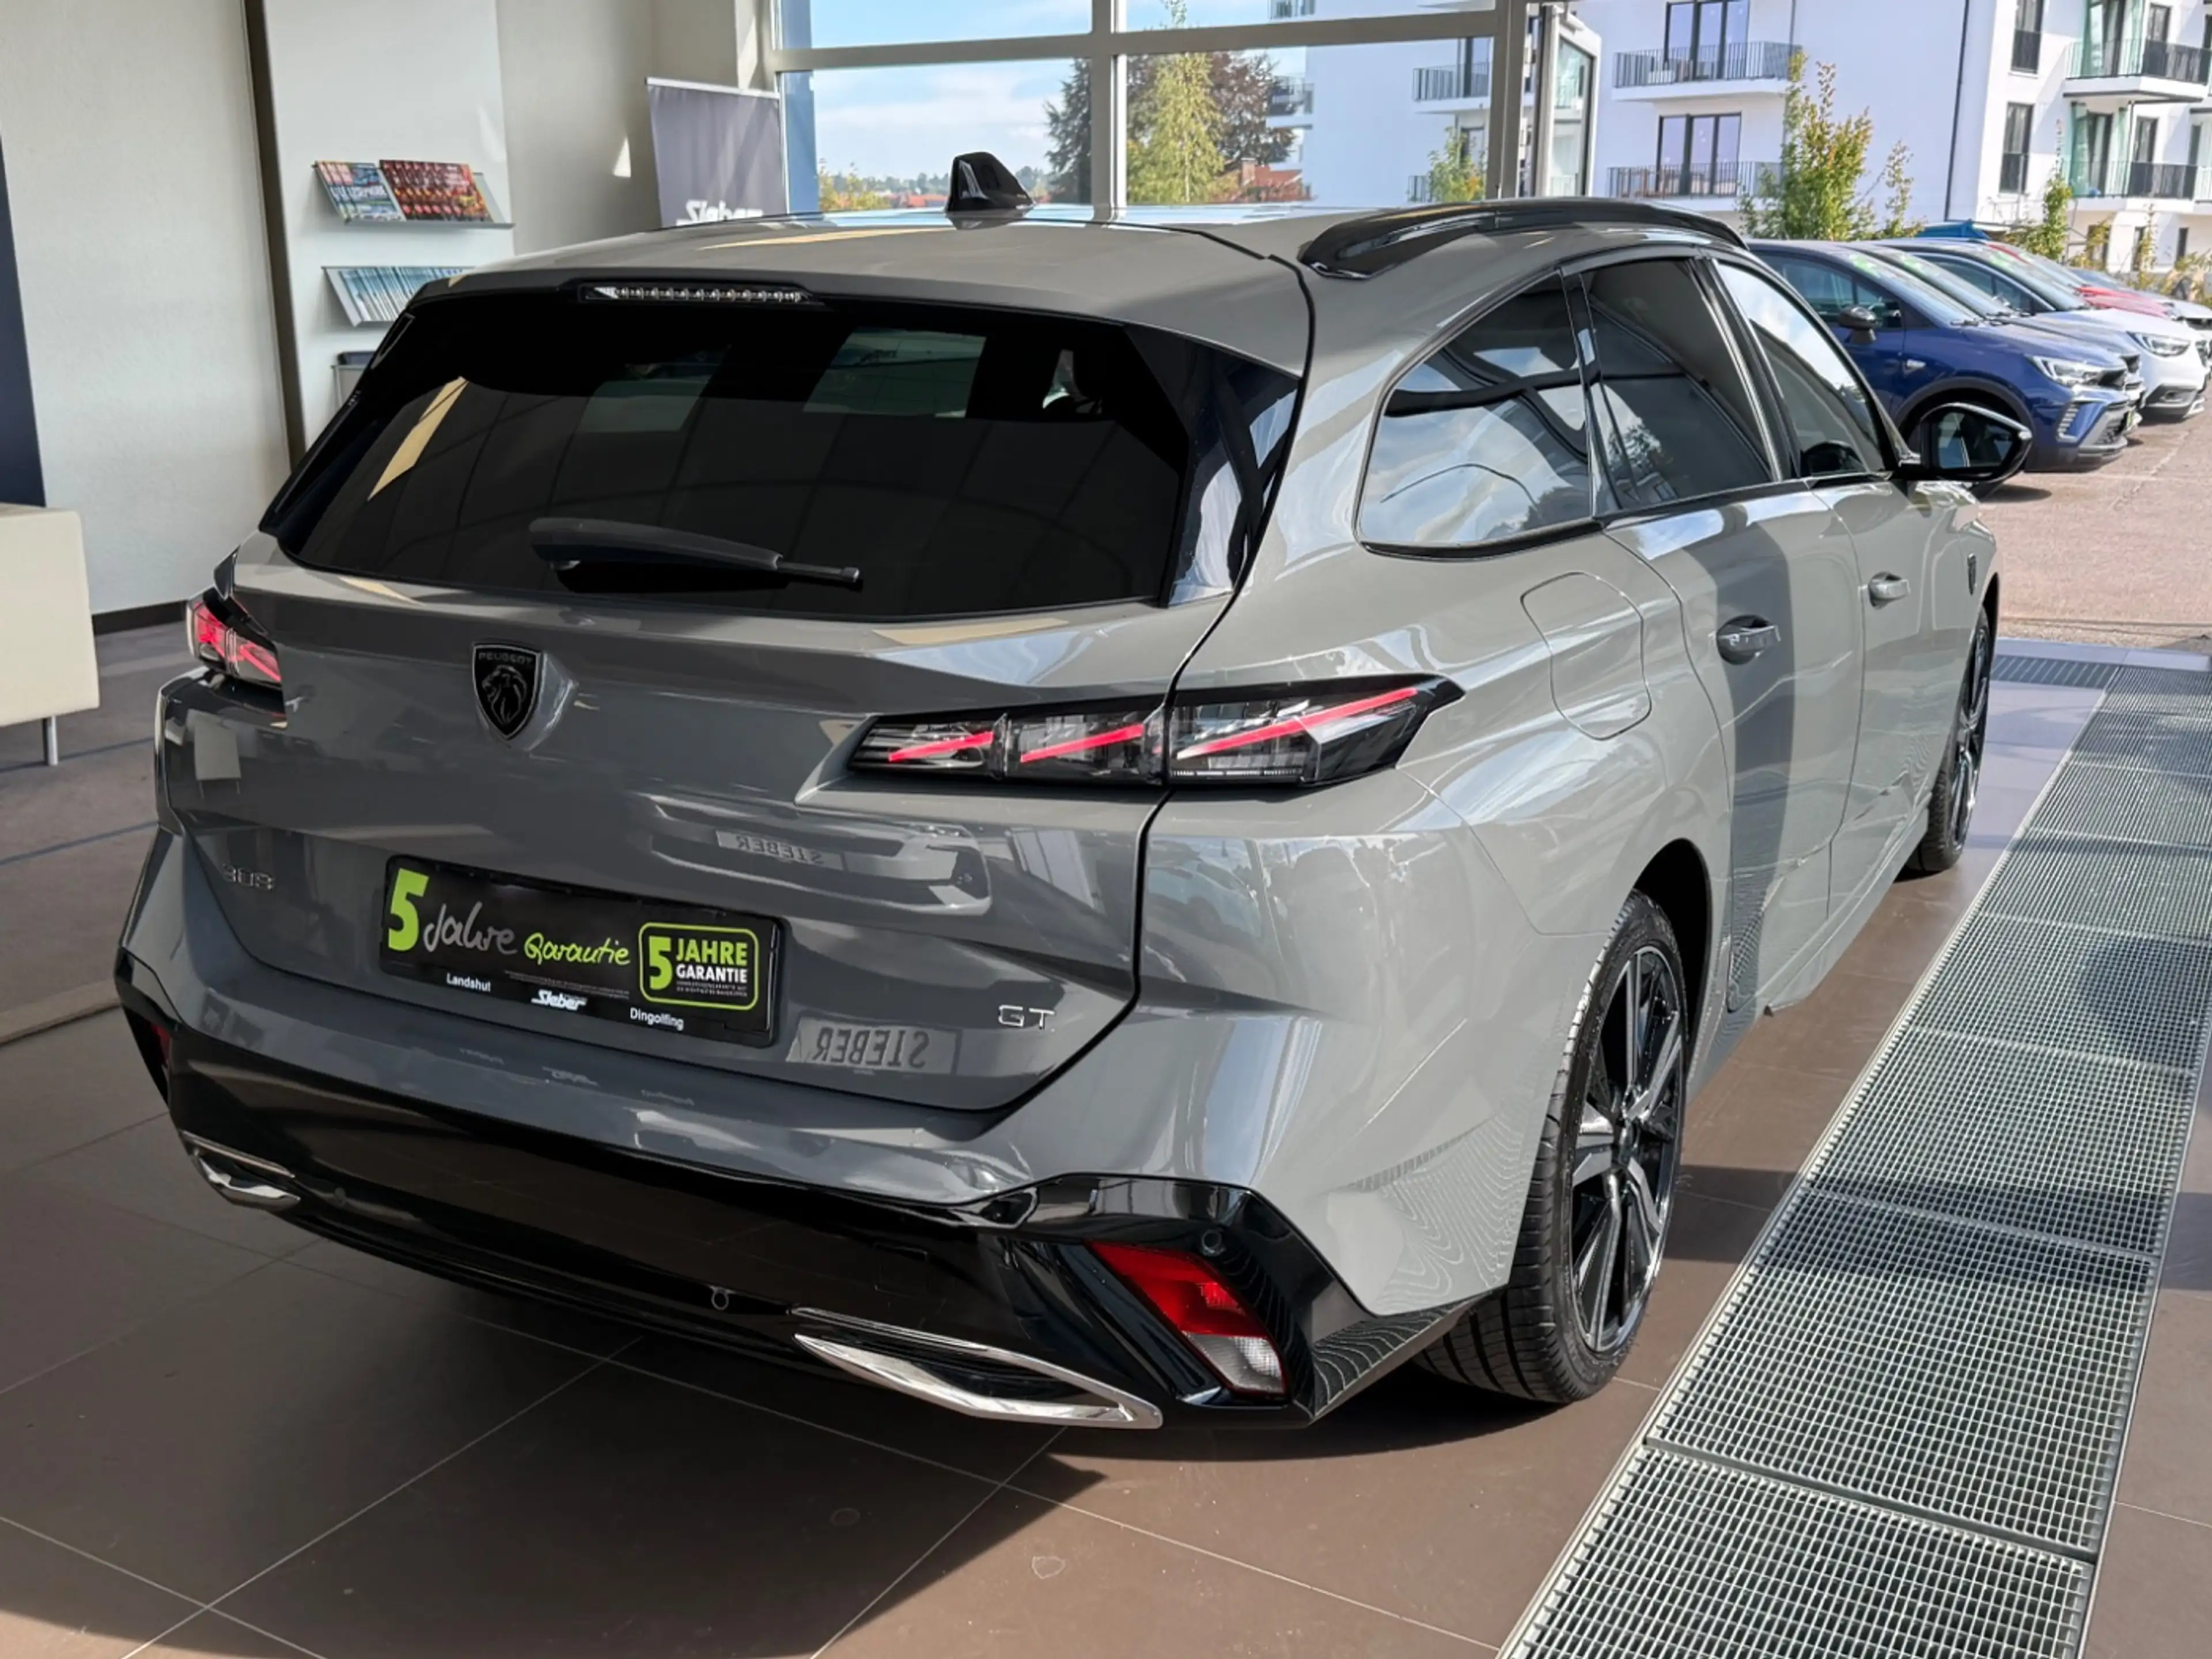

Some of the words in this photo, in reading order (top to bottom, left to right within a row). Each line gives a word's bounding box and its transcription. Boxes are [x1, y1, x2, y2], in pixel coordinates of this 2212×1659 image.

[478, 652, 533, 664] PEUGEOT
[388, 868, 429, 952] 5
[423, 901, 518, 955] Jahre
[524, 932, 631, 966] Garantie
[649, 935, 673, 990] 5
[676, 938, 748, 966] JAHRE
[676, 964, 748, 983] GARANTIE
[446, 972, 491, 993] Landshut
[531, 989, 586, 1011] Sieber
[630, 1007, 684, 1031] Dingolfing
[998, 1004, 1055, 1030] GT
